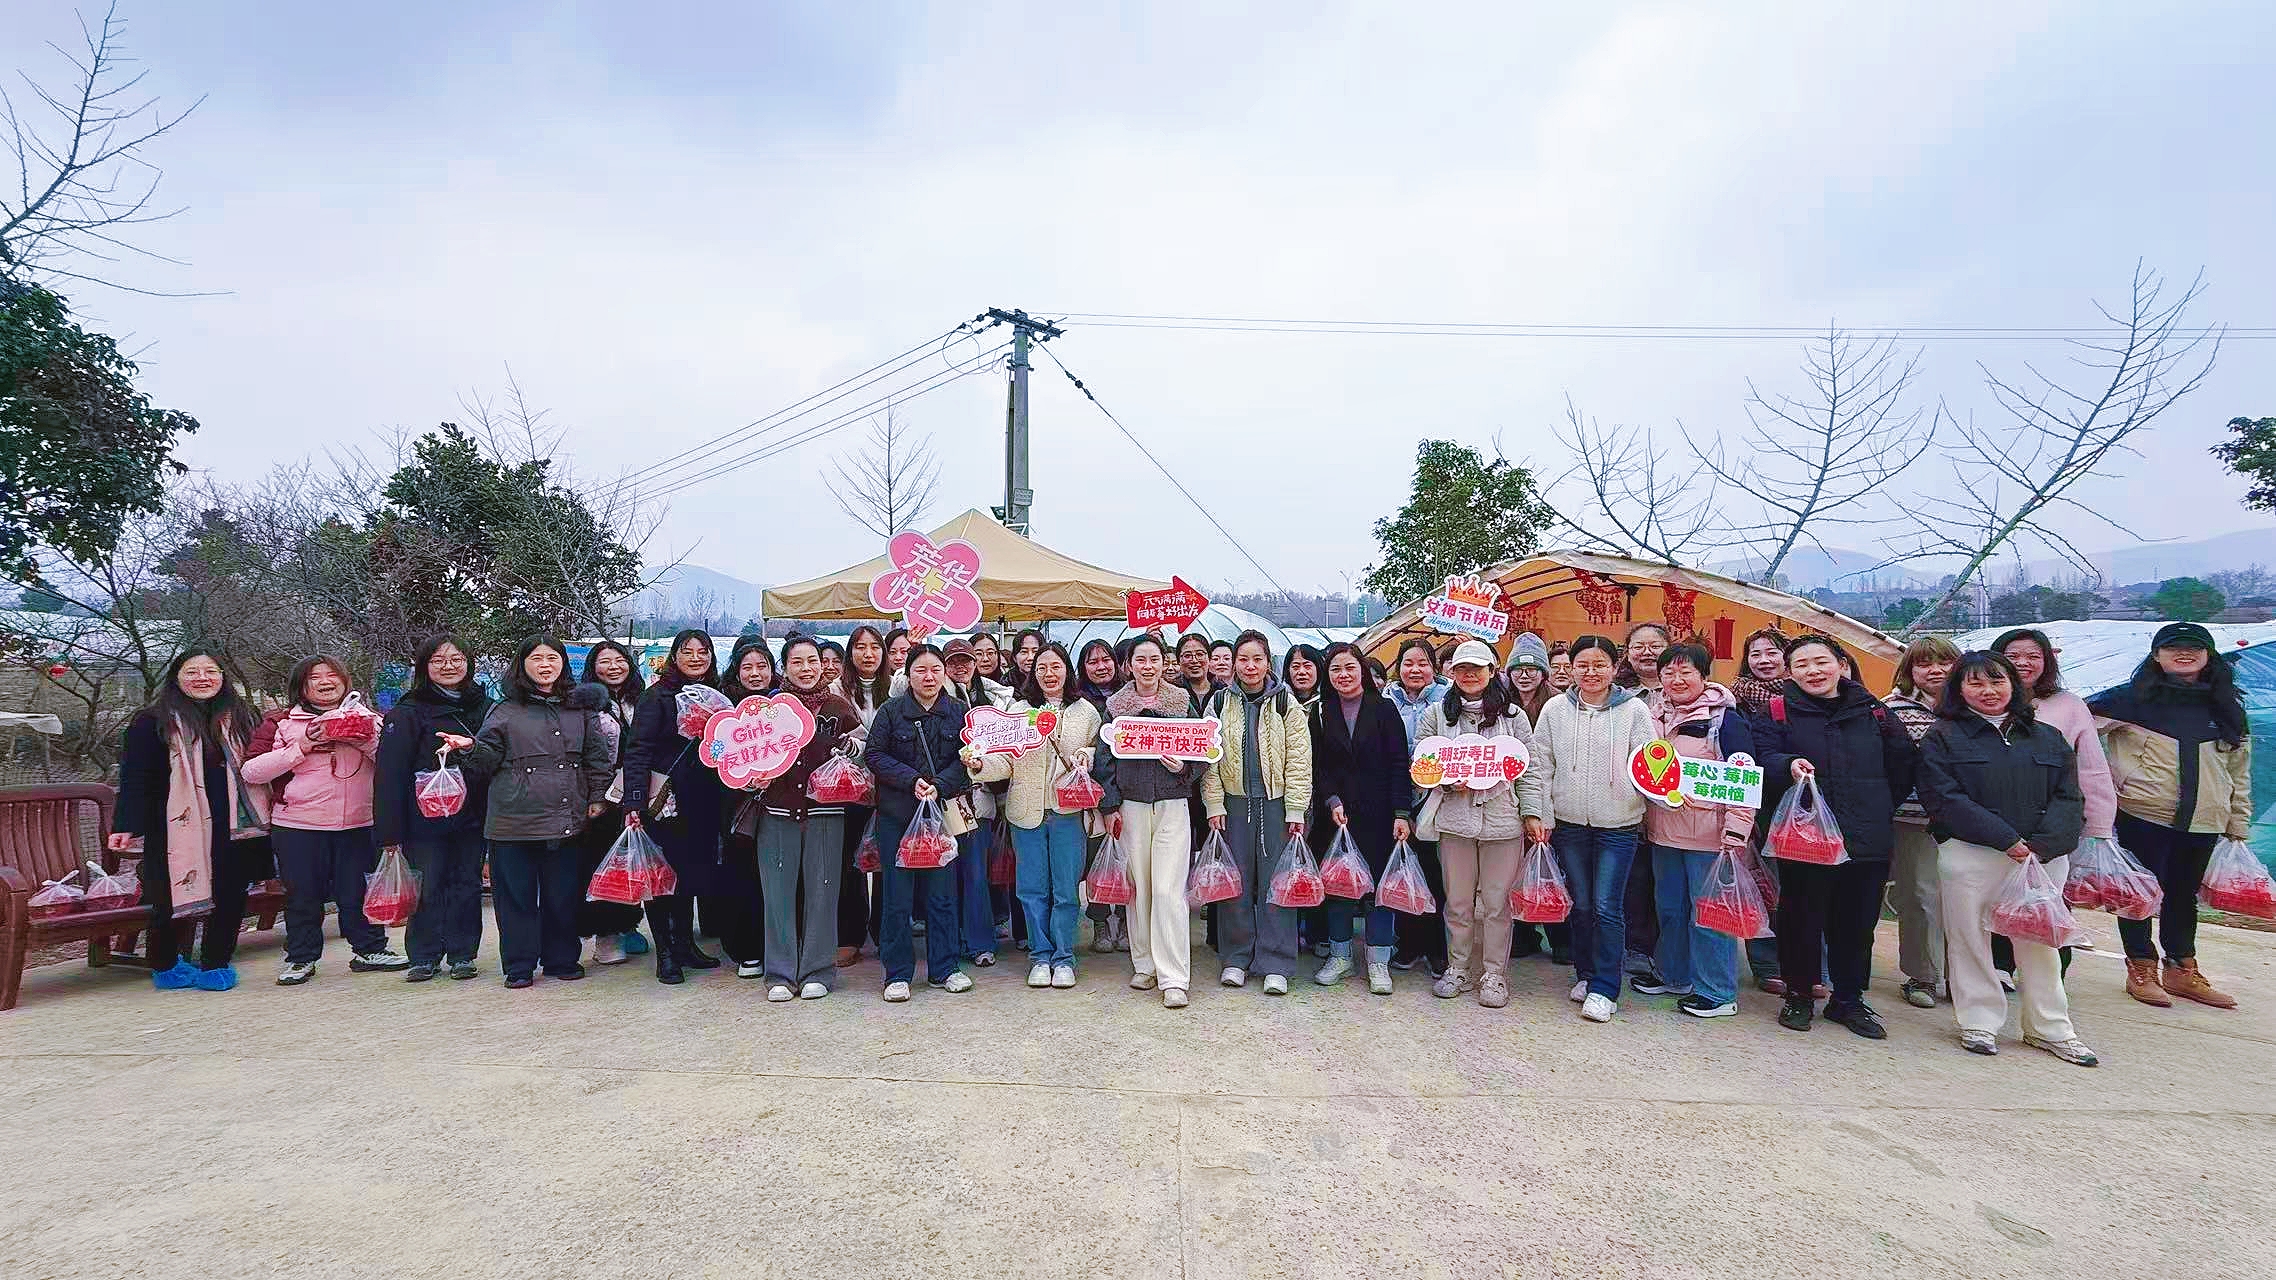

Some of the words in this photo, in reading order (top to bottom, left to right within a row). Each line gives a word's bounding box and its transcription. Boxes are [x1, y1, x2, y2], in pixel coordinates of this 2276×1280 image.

[901, 542, 971, 591] 芳华
[886, 572, 954, 625] 悦己
[1426, 598, 1505, 631] 女神节快乐
[732, 720, 773, 743] Girls
[1121, 724, 1149, 732] HAPPY
[1151, 726, 1190, 734] WOMEN'S
[722, 734, 799, 771] 友好大会
[1121, 733, 1208, 753] 女神节快乐
[1682, 761, 1718, 781] 莓心
[1723, 767, 1761, 787] 莓肺
[1694, 782, 1745, 803] 莓烦恼
